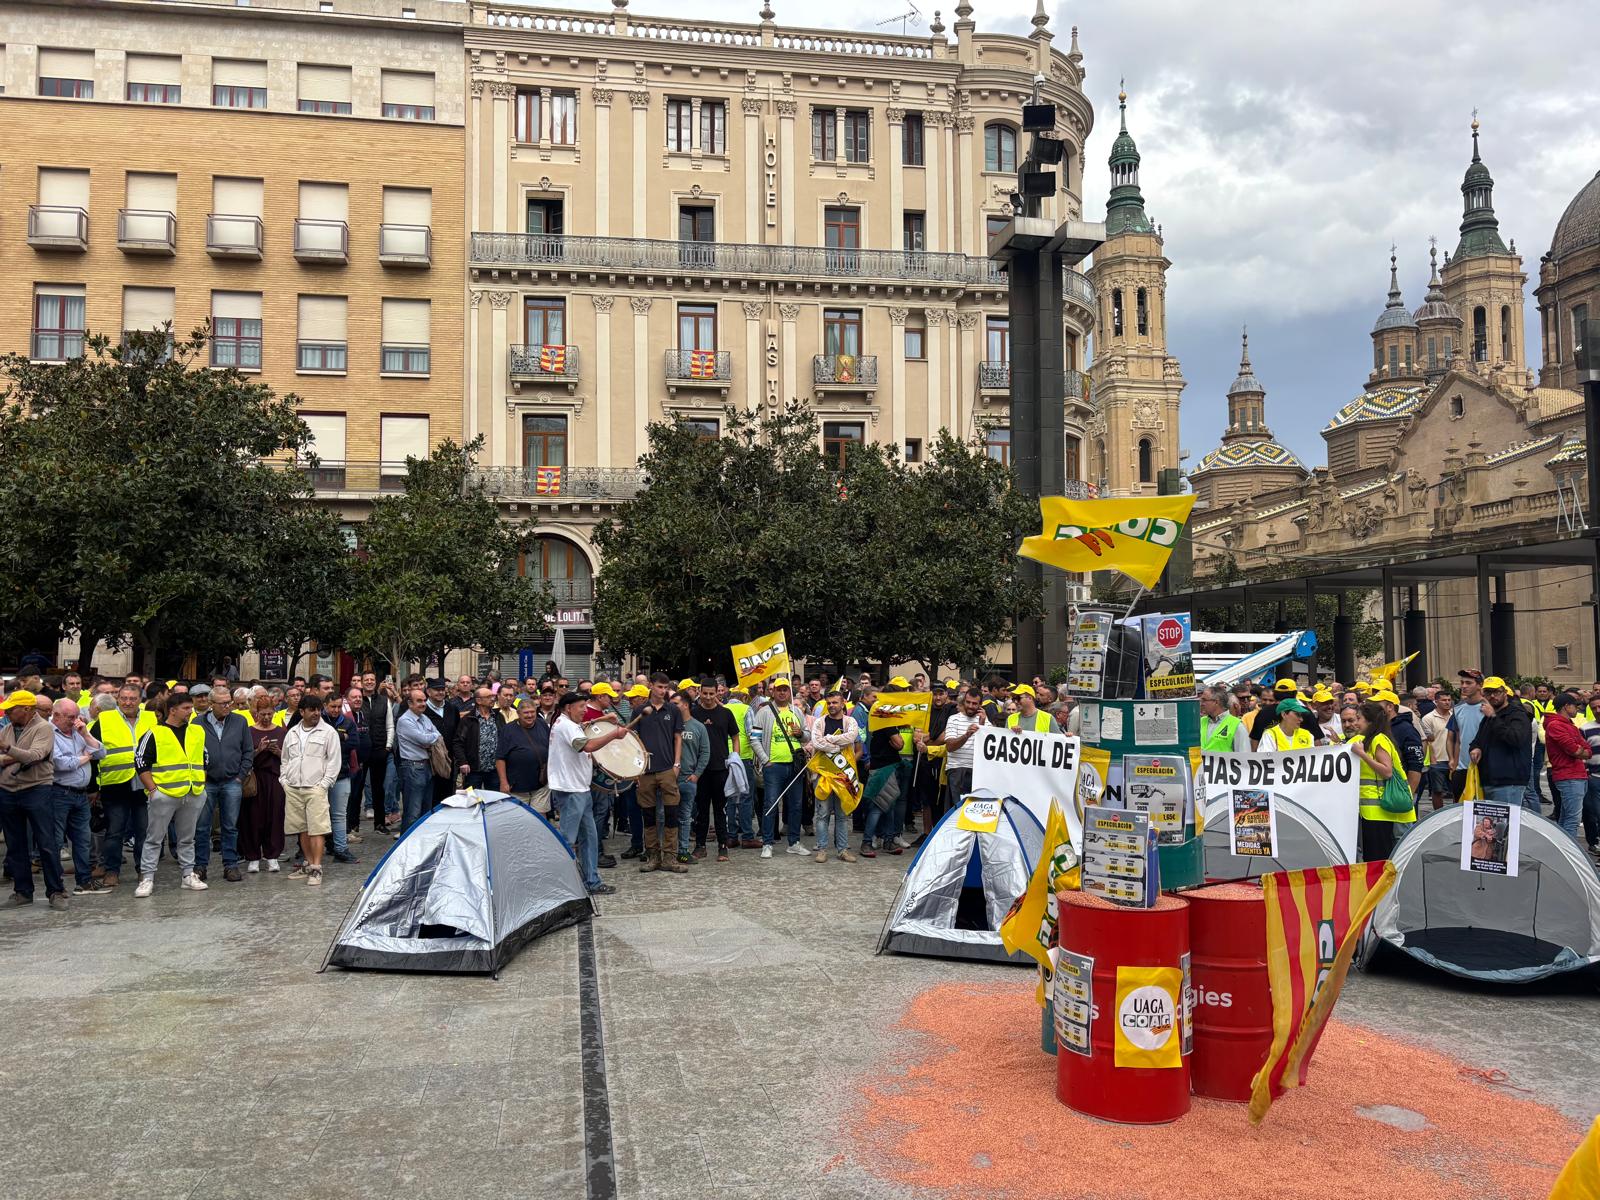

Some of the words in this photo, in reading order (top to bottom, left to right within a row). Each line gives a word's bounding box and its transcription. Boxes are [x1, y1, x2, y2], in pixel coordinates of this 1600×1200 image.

[765, 131, 776, 226] HOTEL
[767, 321, 778, 366] LAS
[558, 611, 584, 622] LOLITA
[1160, 627, 1180, 640] STOP
[1150, 675, 1193, 687] ESPECULACIÓN
[984, 734, 1046, 767] GASOIL
[1052, 741, 1075, 770] DE
[1202, 755, 1241, 785] HAS
[1248, 758, 1275, 785] DE
[1282, 752, 1351, 785] SALDO
[1237, 841, 1260, 849] MEDIDAS
[1263, 847, 1270, 855] YA
[1134, 998, 1163, 1013] UAGA
[1123, 1014, 1170, 1028] COAG
